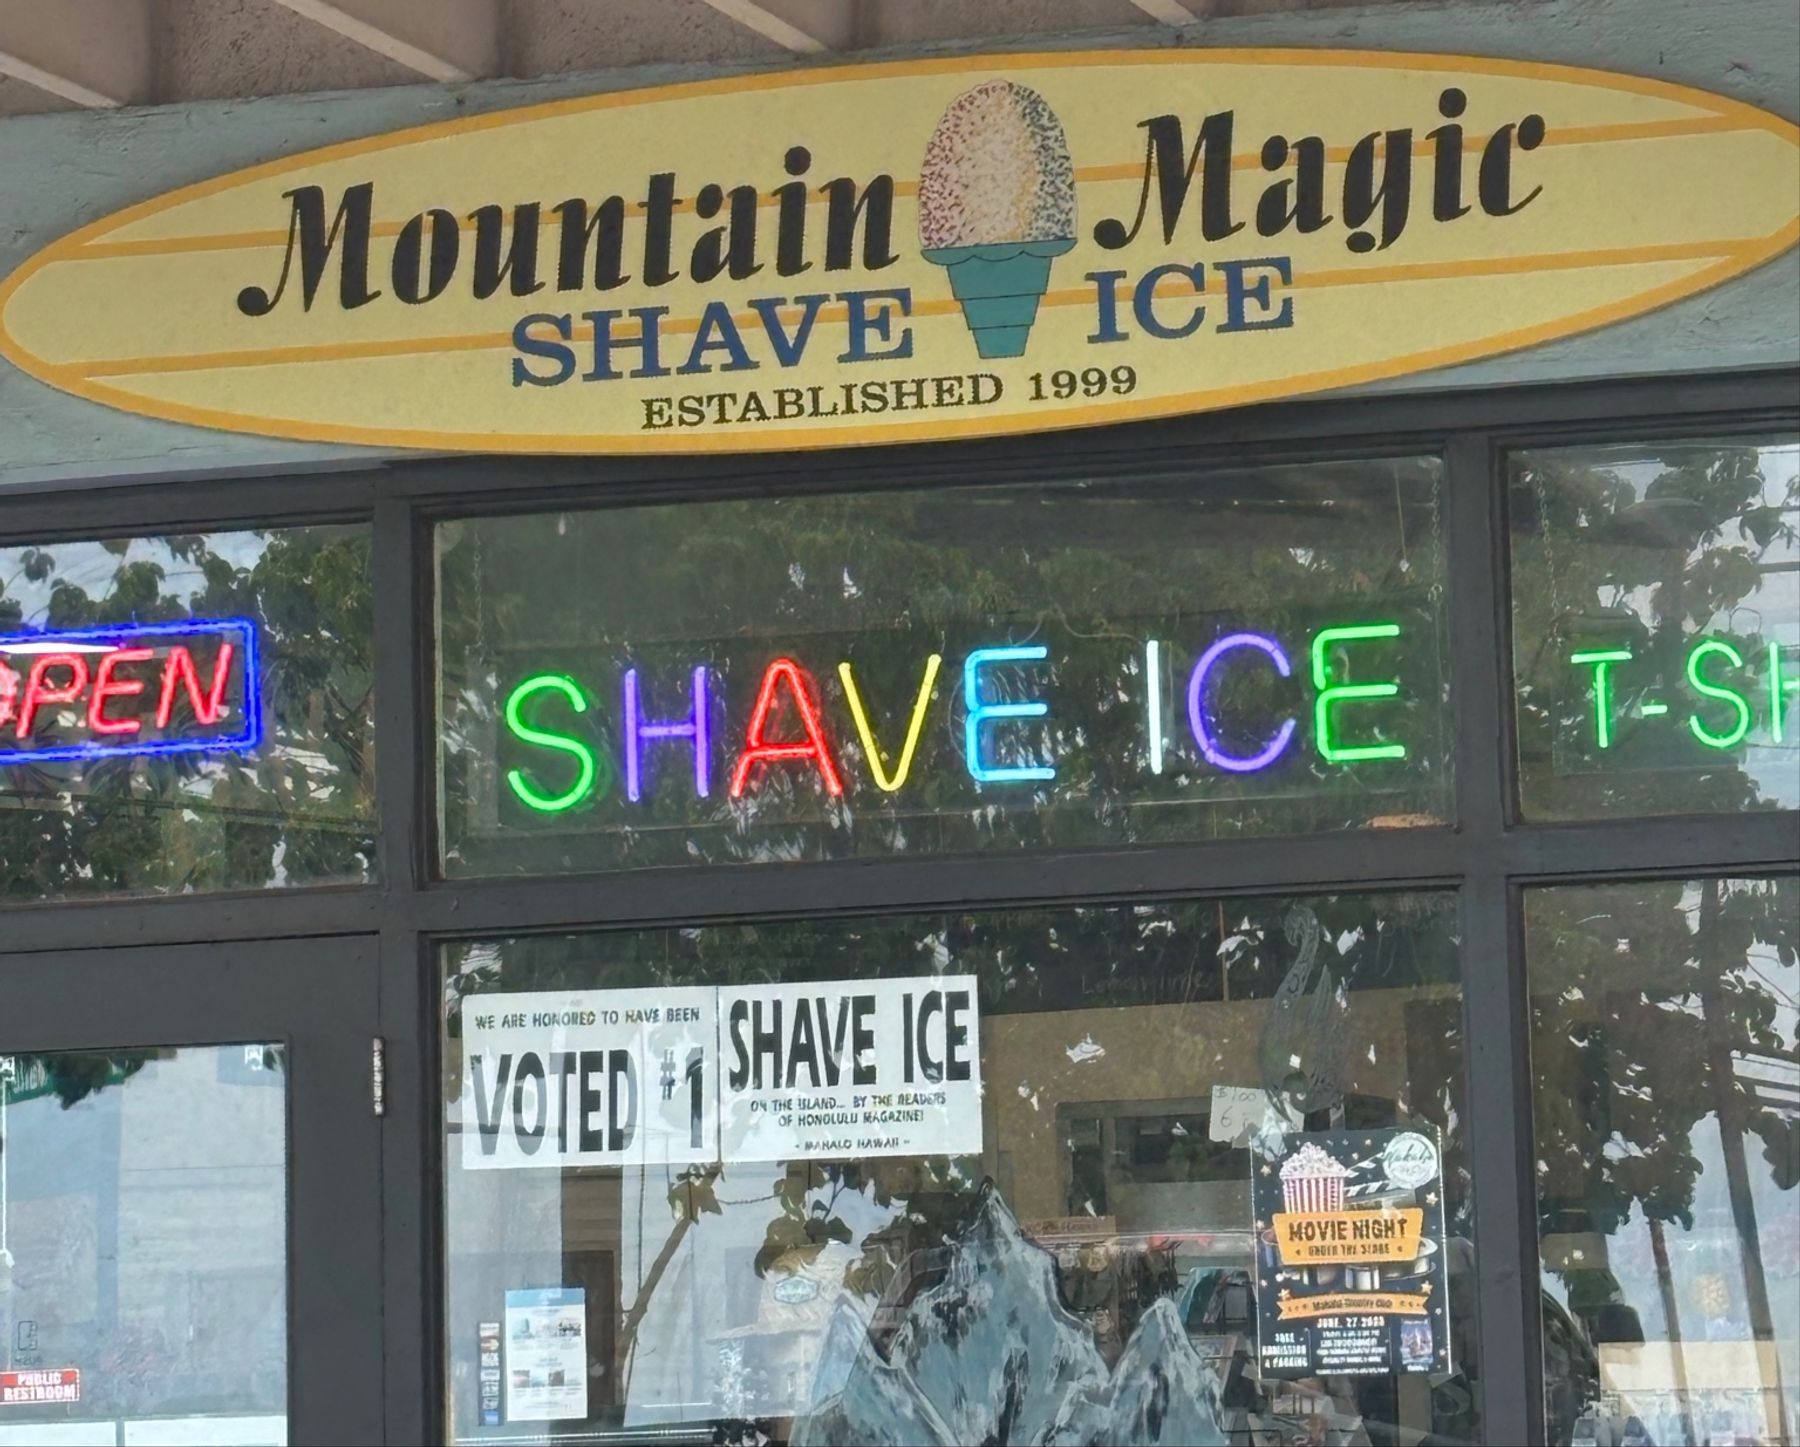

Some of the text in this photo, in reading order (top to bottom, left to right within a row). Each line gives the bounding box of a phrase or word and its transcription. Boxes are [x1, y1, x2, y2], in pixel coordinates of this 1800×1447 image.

[237, 87, 1546, 317] Mountain Magic
[511, 255, 1293, 388] SHAVE ICE
[641, 365, 1137, 429] ESTABLISHED 1999
[505, 623, 1407, 812] SHAVE ICE
[475, 1007, 700, 1030] WE ARE HONORED TO HAVE BEEN
[729, 990, 972, 1093] SHAVE ICE
[469, 1047, 704, 1157] VOTED #1
[751, 1099, 768, 1113] ON
[771, 1098, 793, 1112] THE
[853, 1095, 868, 1108] BY
[872, 1094, 893, 1107] THE
[897, 1092, 946, 1106] READERS
[778, 1114, 793, 1127] OF
[798, 1111, 858, 1127] HONOLULU
[1288, 1218, 1408, 1241] MOVIE NIGHT
[3, 1384, 76, 1401] RESTROOM
[17, 1372, 62, 1386] PUBLIC
